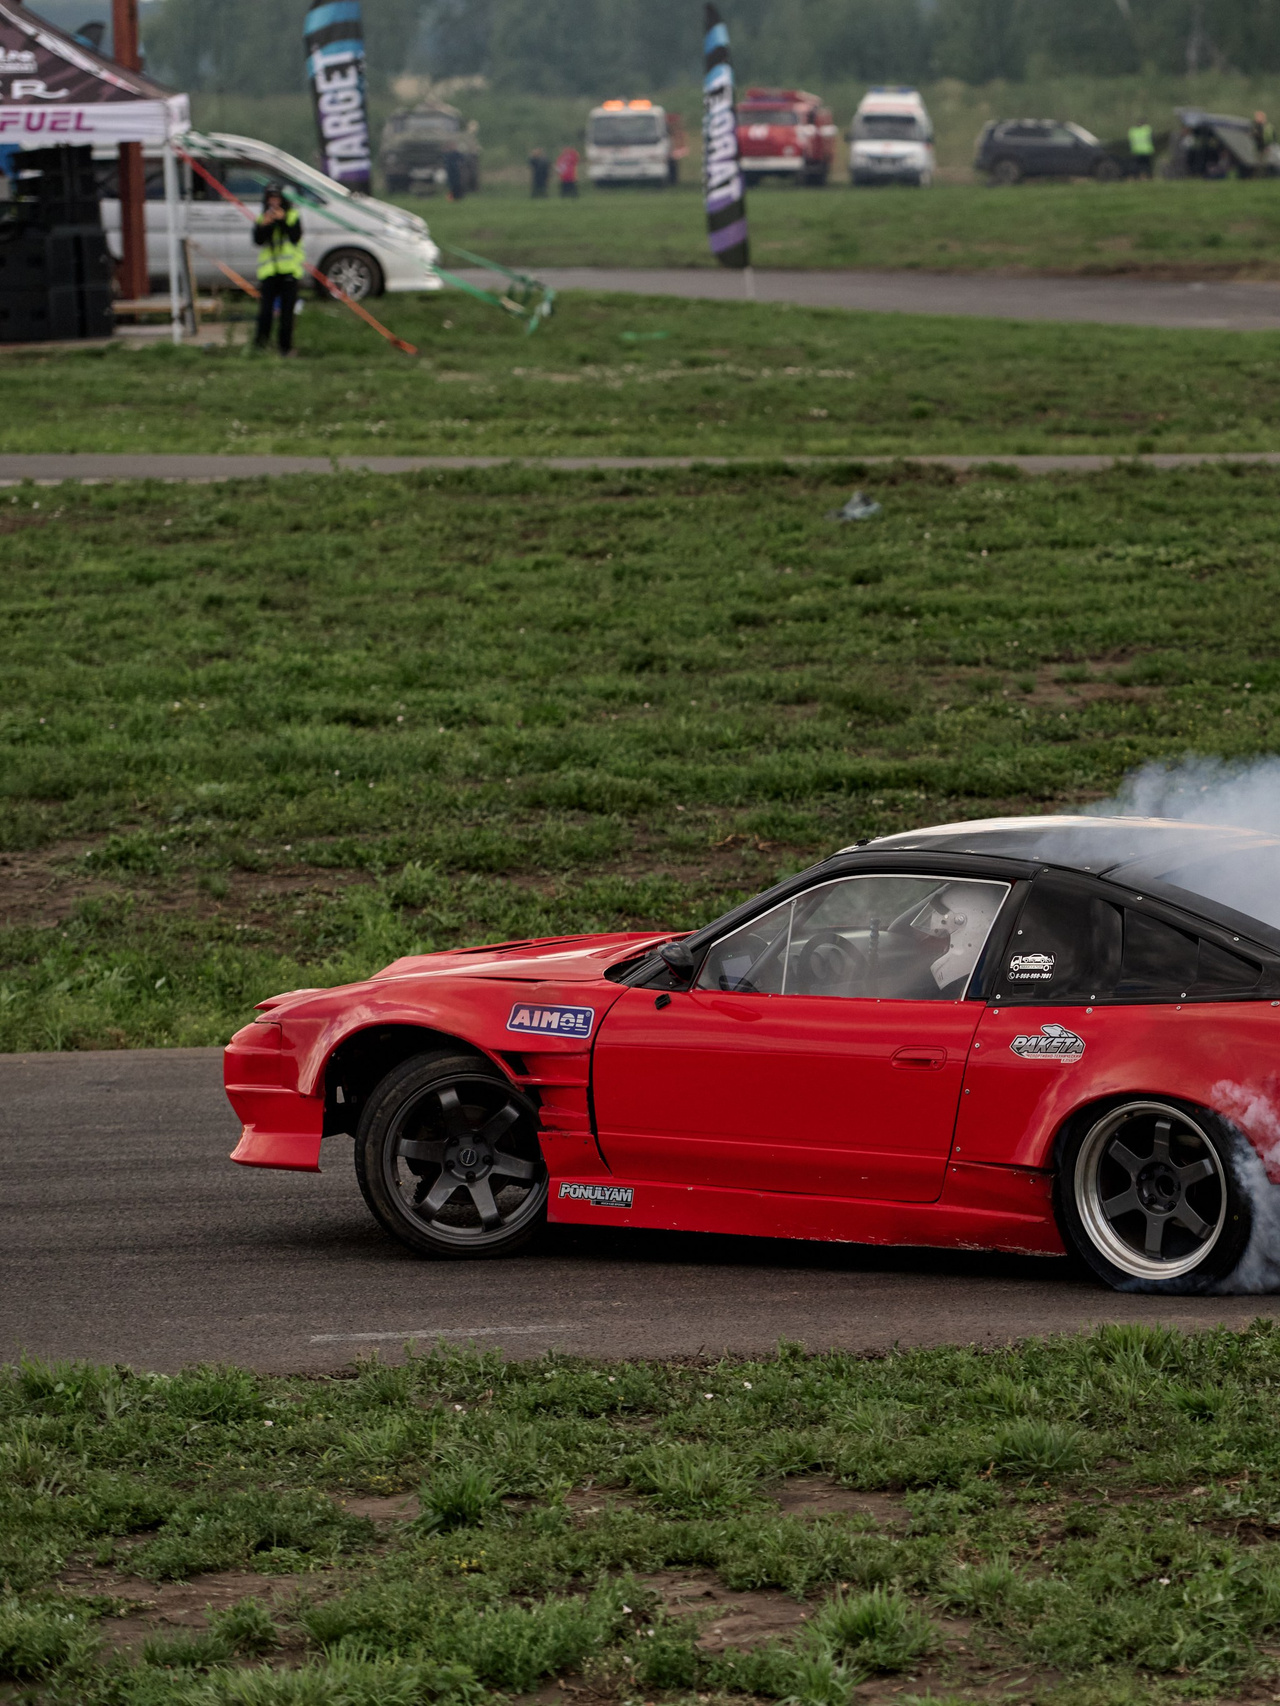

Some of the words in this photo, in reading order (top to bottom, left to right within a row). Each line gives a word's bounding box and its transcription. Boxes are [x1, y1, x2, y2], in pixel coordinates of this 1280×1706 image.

[0, 111, 94, 132] FUEL
[312, 50, 371, 180] TARGET
[511, 1009, 588, 1032] AIMOL
[560, 1183, 633, 1202] PONULYAM
